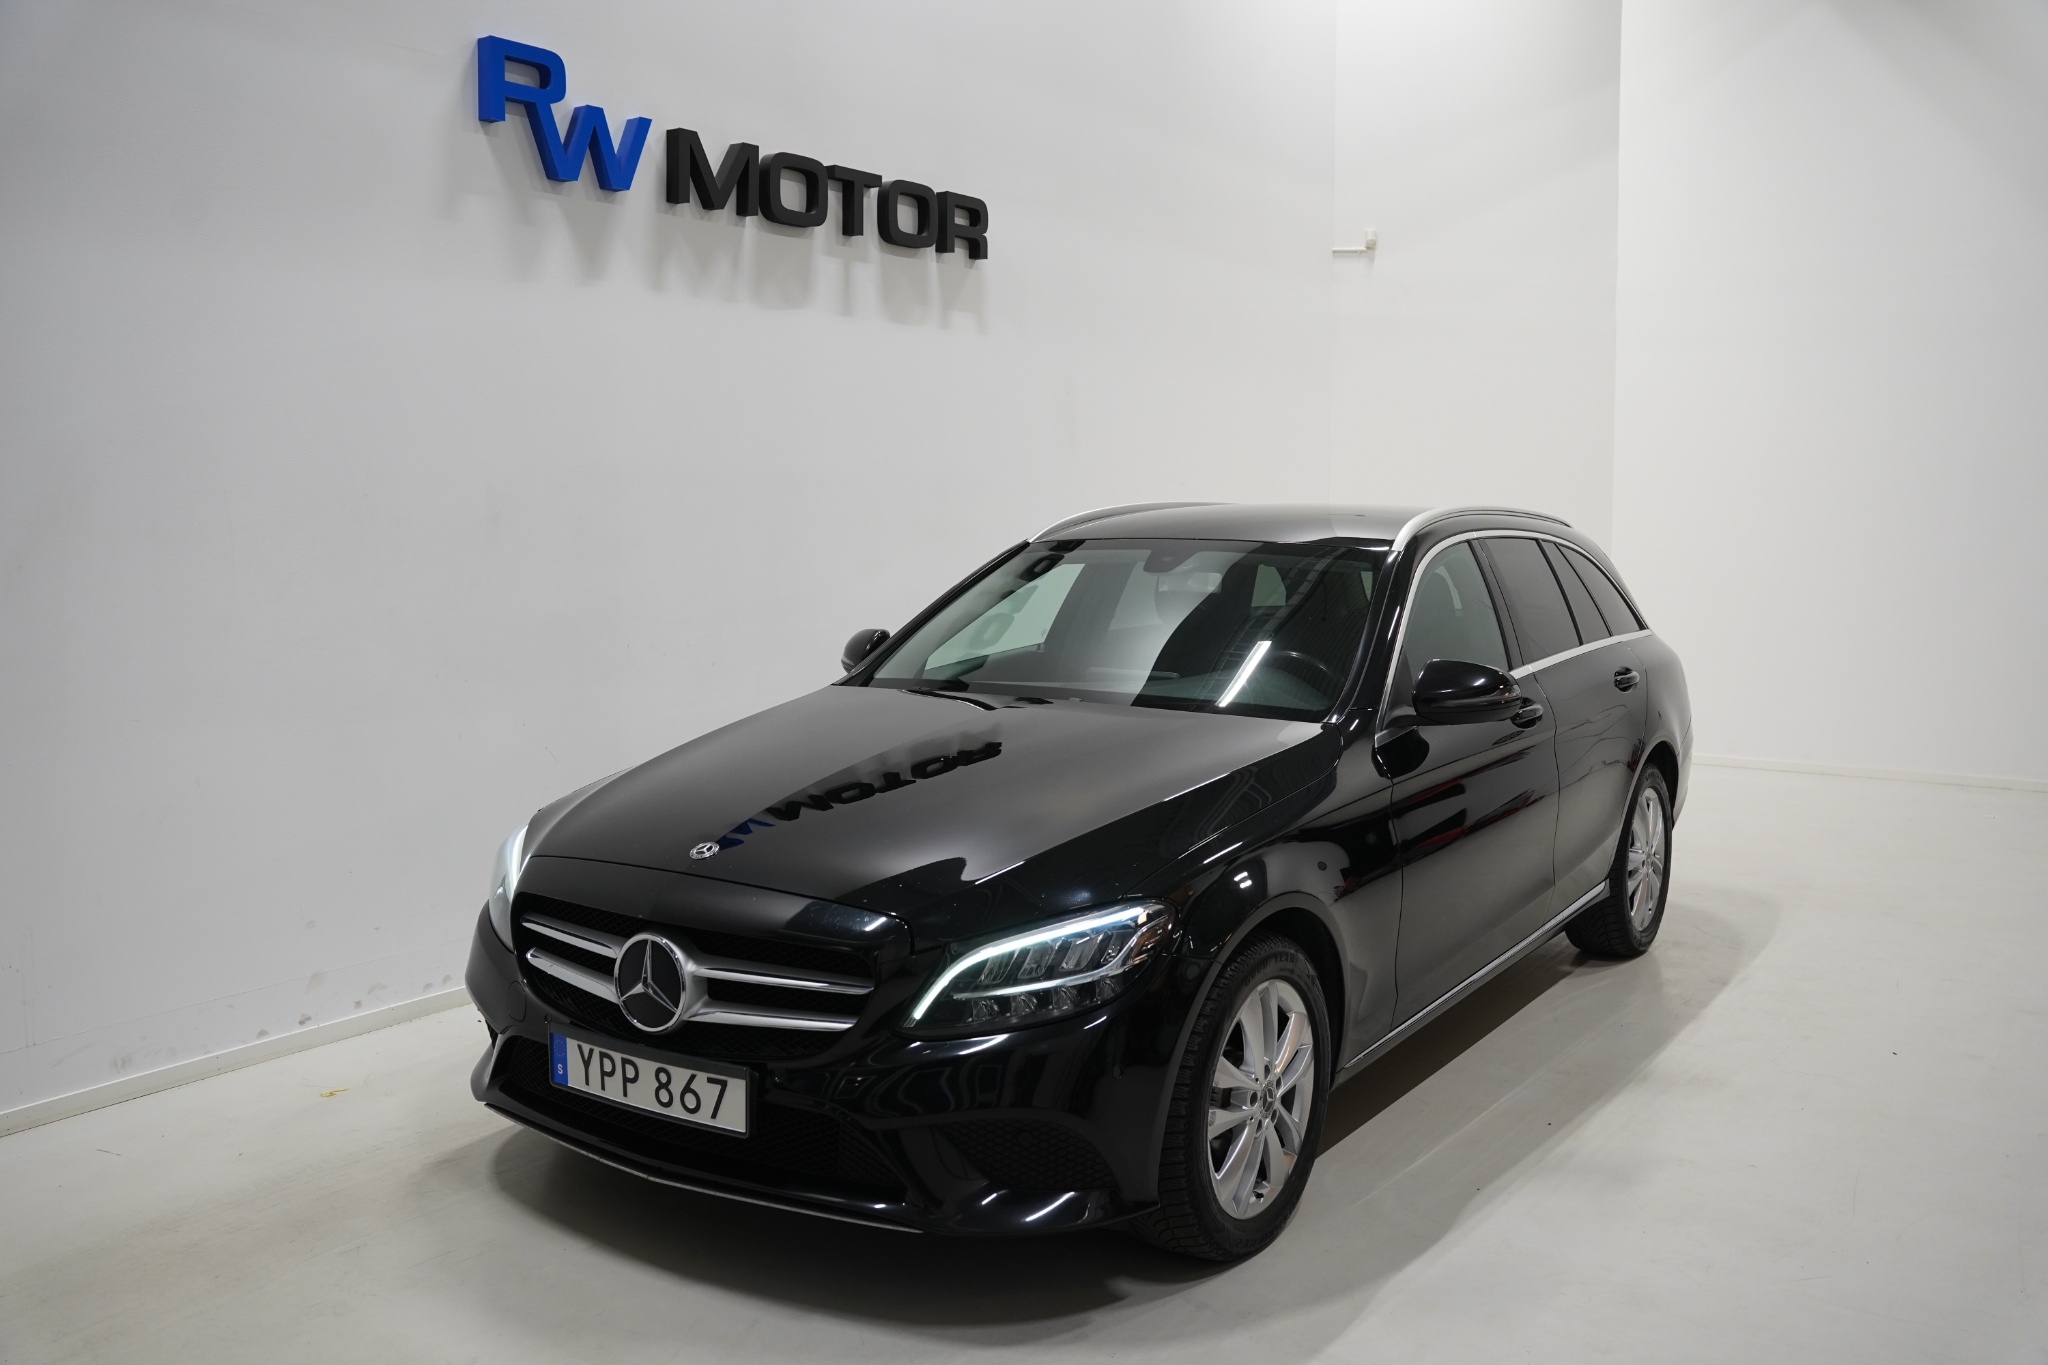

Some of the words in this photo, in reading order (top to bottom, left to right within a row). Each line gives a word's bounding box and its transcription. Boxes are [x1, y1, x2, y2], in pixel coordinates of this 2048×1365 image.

[478, 35, 652, 192] RW
[667, 127, 988, 261] MOTOR
[557, 1063, 563, 1075] S
[577, 1043, 640, 1098] YPP
[654, 1066, 728, 1119] 867
